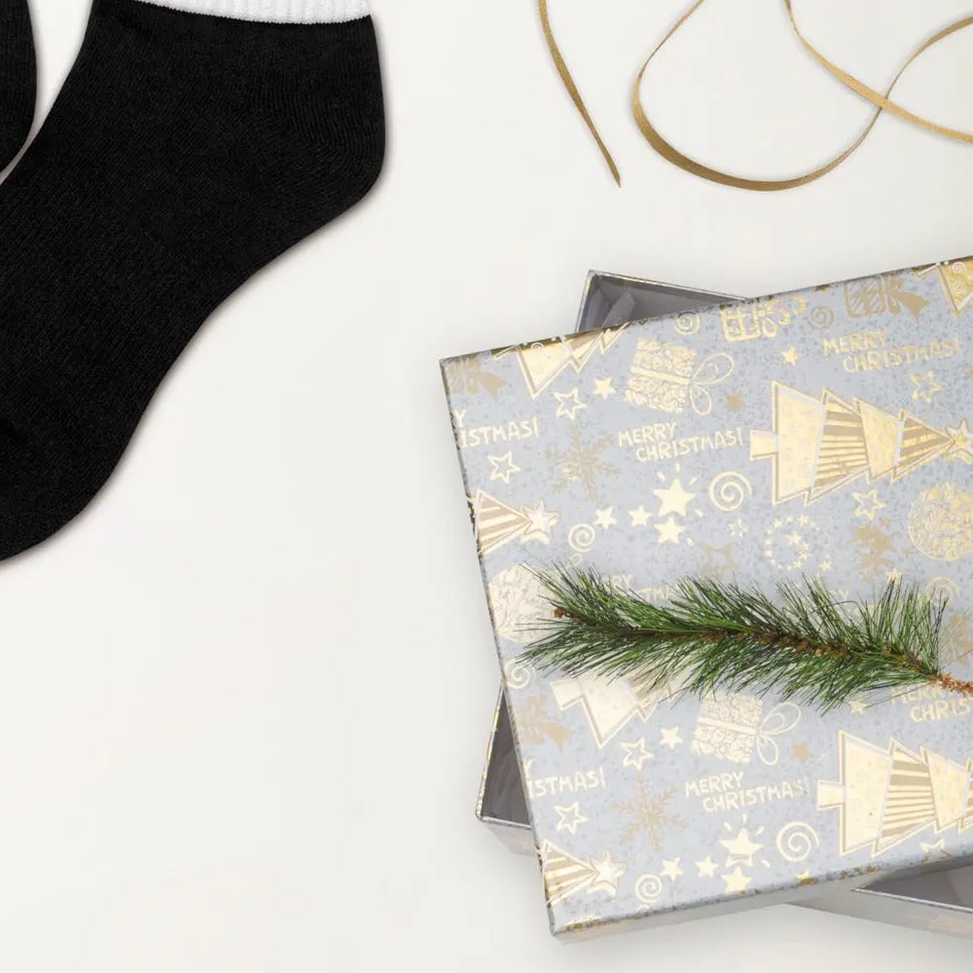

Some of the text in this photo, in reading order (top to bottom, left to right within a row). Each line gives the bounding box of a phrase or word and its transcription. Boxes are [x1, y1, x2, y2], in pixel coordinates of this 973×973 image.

[822, 329, 888, 357] MERRY
[842, 333, 961, 374] CHRISTMAS!
[618, 421, 677, 448] MERRY
[636, 426, 744, 463] CHRISTMAS!
[684, 770, 744, 799] MERRY
[702, 774, 811, 813] CHRISTMAS!
